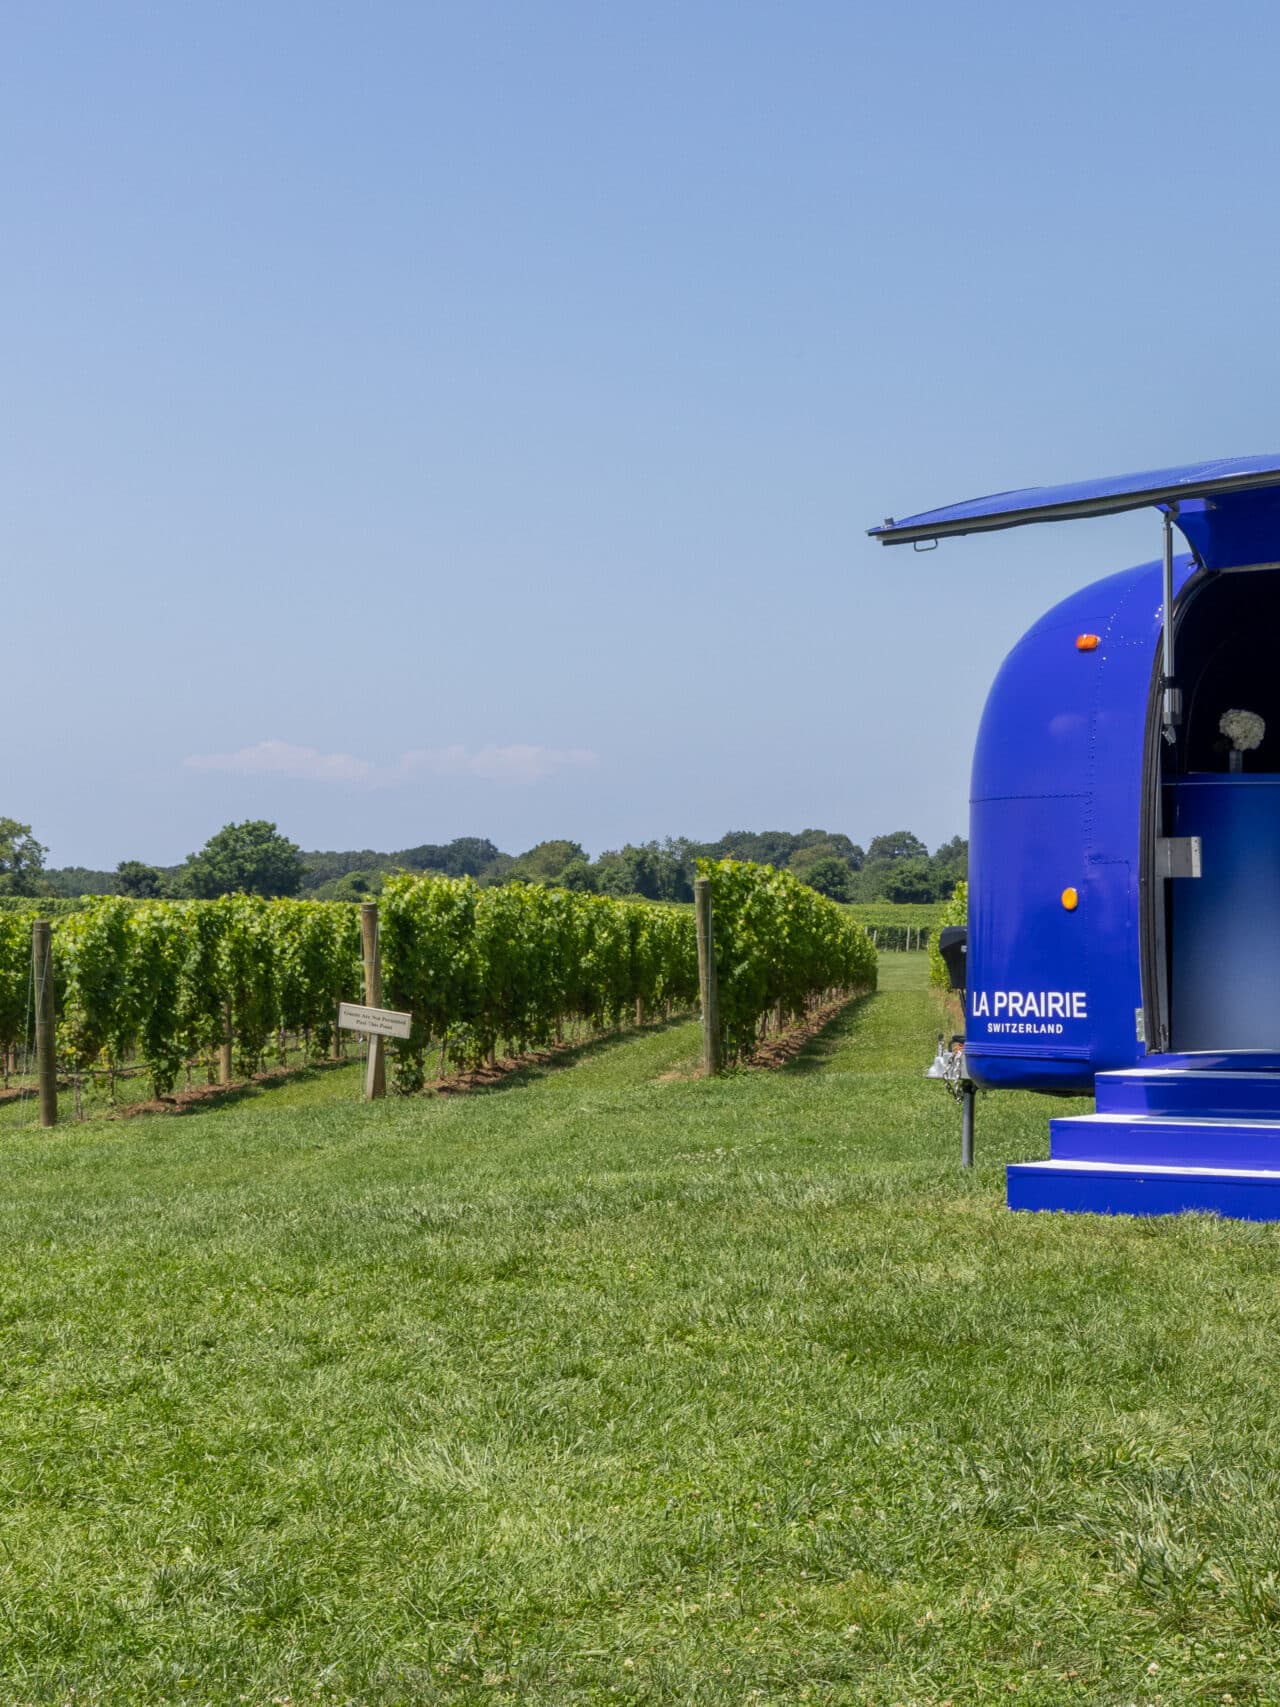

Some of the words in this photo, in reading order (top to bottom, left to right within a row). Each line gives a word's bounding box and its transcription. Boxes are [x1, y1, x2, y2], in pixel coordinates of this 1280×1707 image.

[973, 991, 990, 1017] LA
[994, 991, 1088, 1018] PRAIRIE
[987, 1023, 1064, 1034] SWITZERLAND
